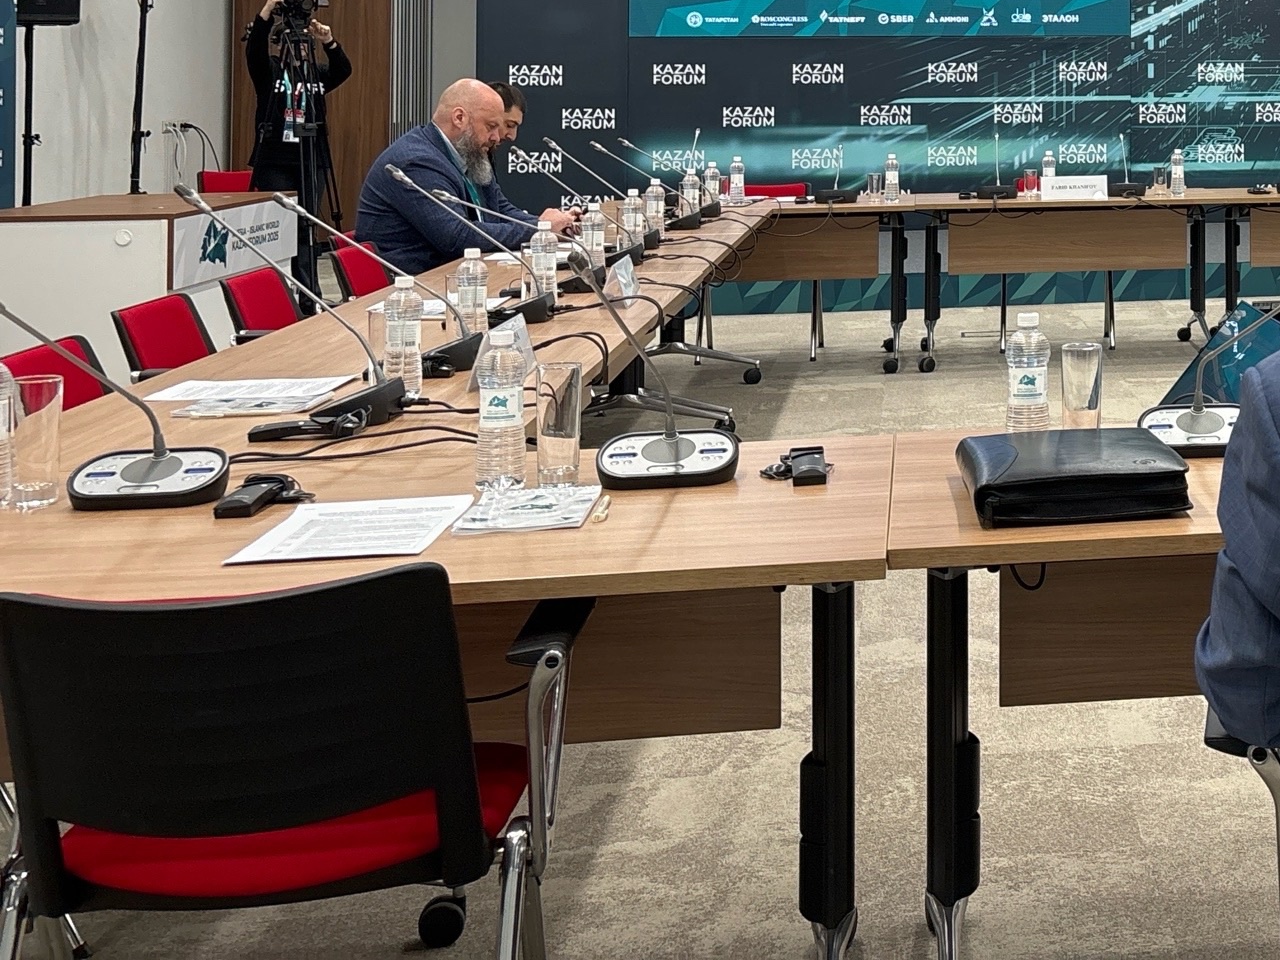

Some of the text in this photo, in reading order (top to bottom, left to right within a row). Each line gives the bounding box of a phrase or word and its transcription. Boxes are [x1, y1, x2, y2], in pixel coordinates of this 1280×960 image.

[890, 15, 914, 23] SBER
[1042, 15, 1079, 23] ЭТАЛОН
[509, 65, 563, 75] KAZAN
[653, 64, 706, 74] KAZAN
[792, 63, 844, 74] KAZAN
[928, 63, 977, 73] KAZAN
[1059, 62, 1107, 72] KAZAN
[509, 75, 563, 86] FORUM
[653, 74, 706, 85] FORUM
[792, 74, 844, 84] FORUM
[928, 73, 977, 82] FORUM
[1059, 72, 1107, 82] FORUM
[562, 108, 615, 119] KAZAN
[723, 107, 775, 117] KAZAN
[861, 105, 911, 116] KAZAN
[562, 119, 615, 129] FORUM
[723, 117, 775, 127] FORUM
[861, 115, 911, 125] FORUM
[1059, 144, 1107, 154] KAZAN
[1059, 154, 1107, 164] FORUM
